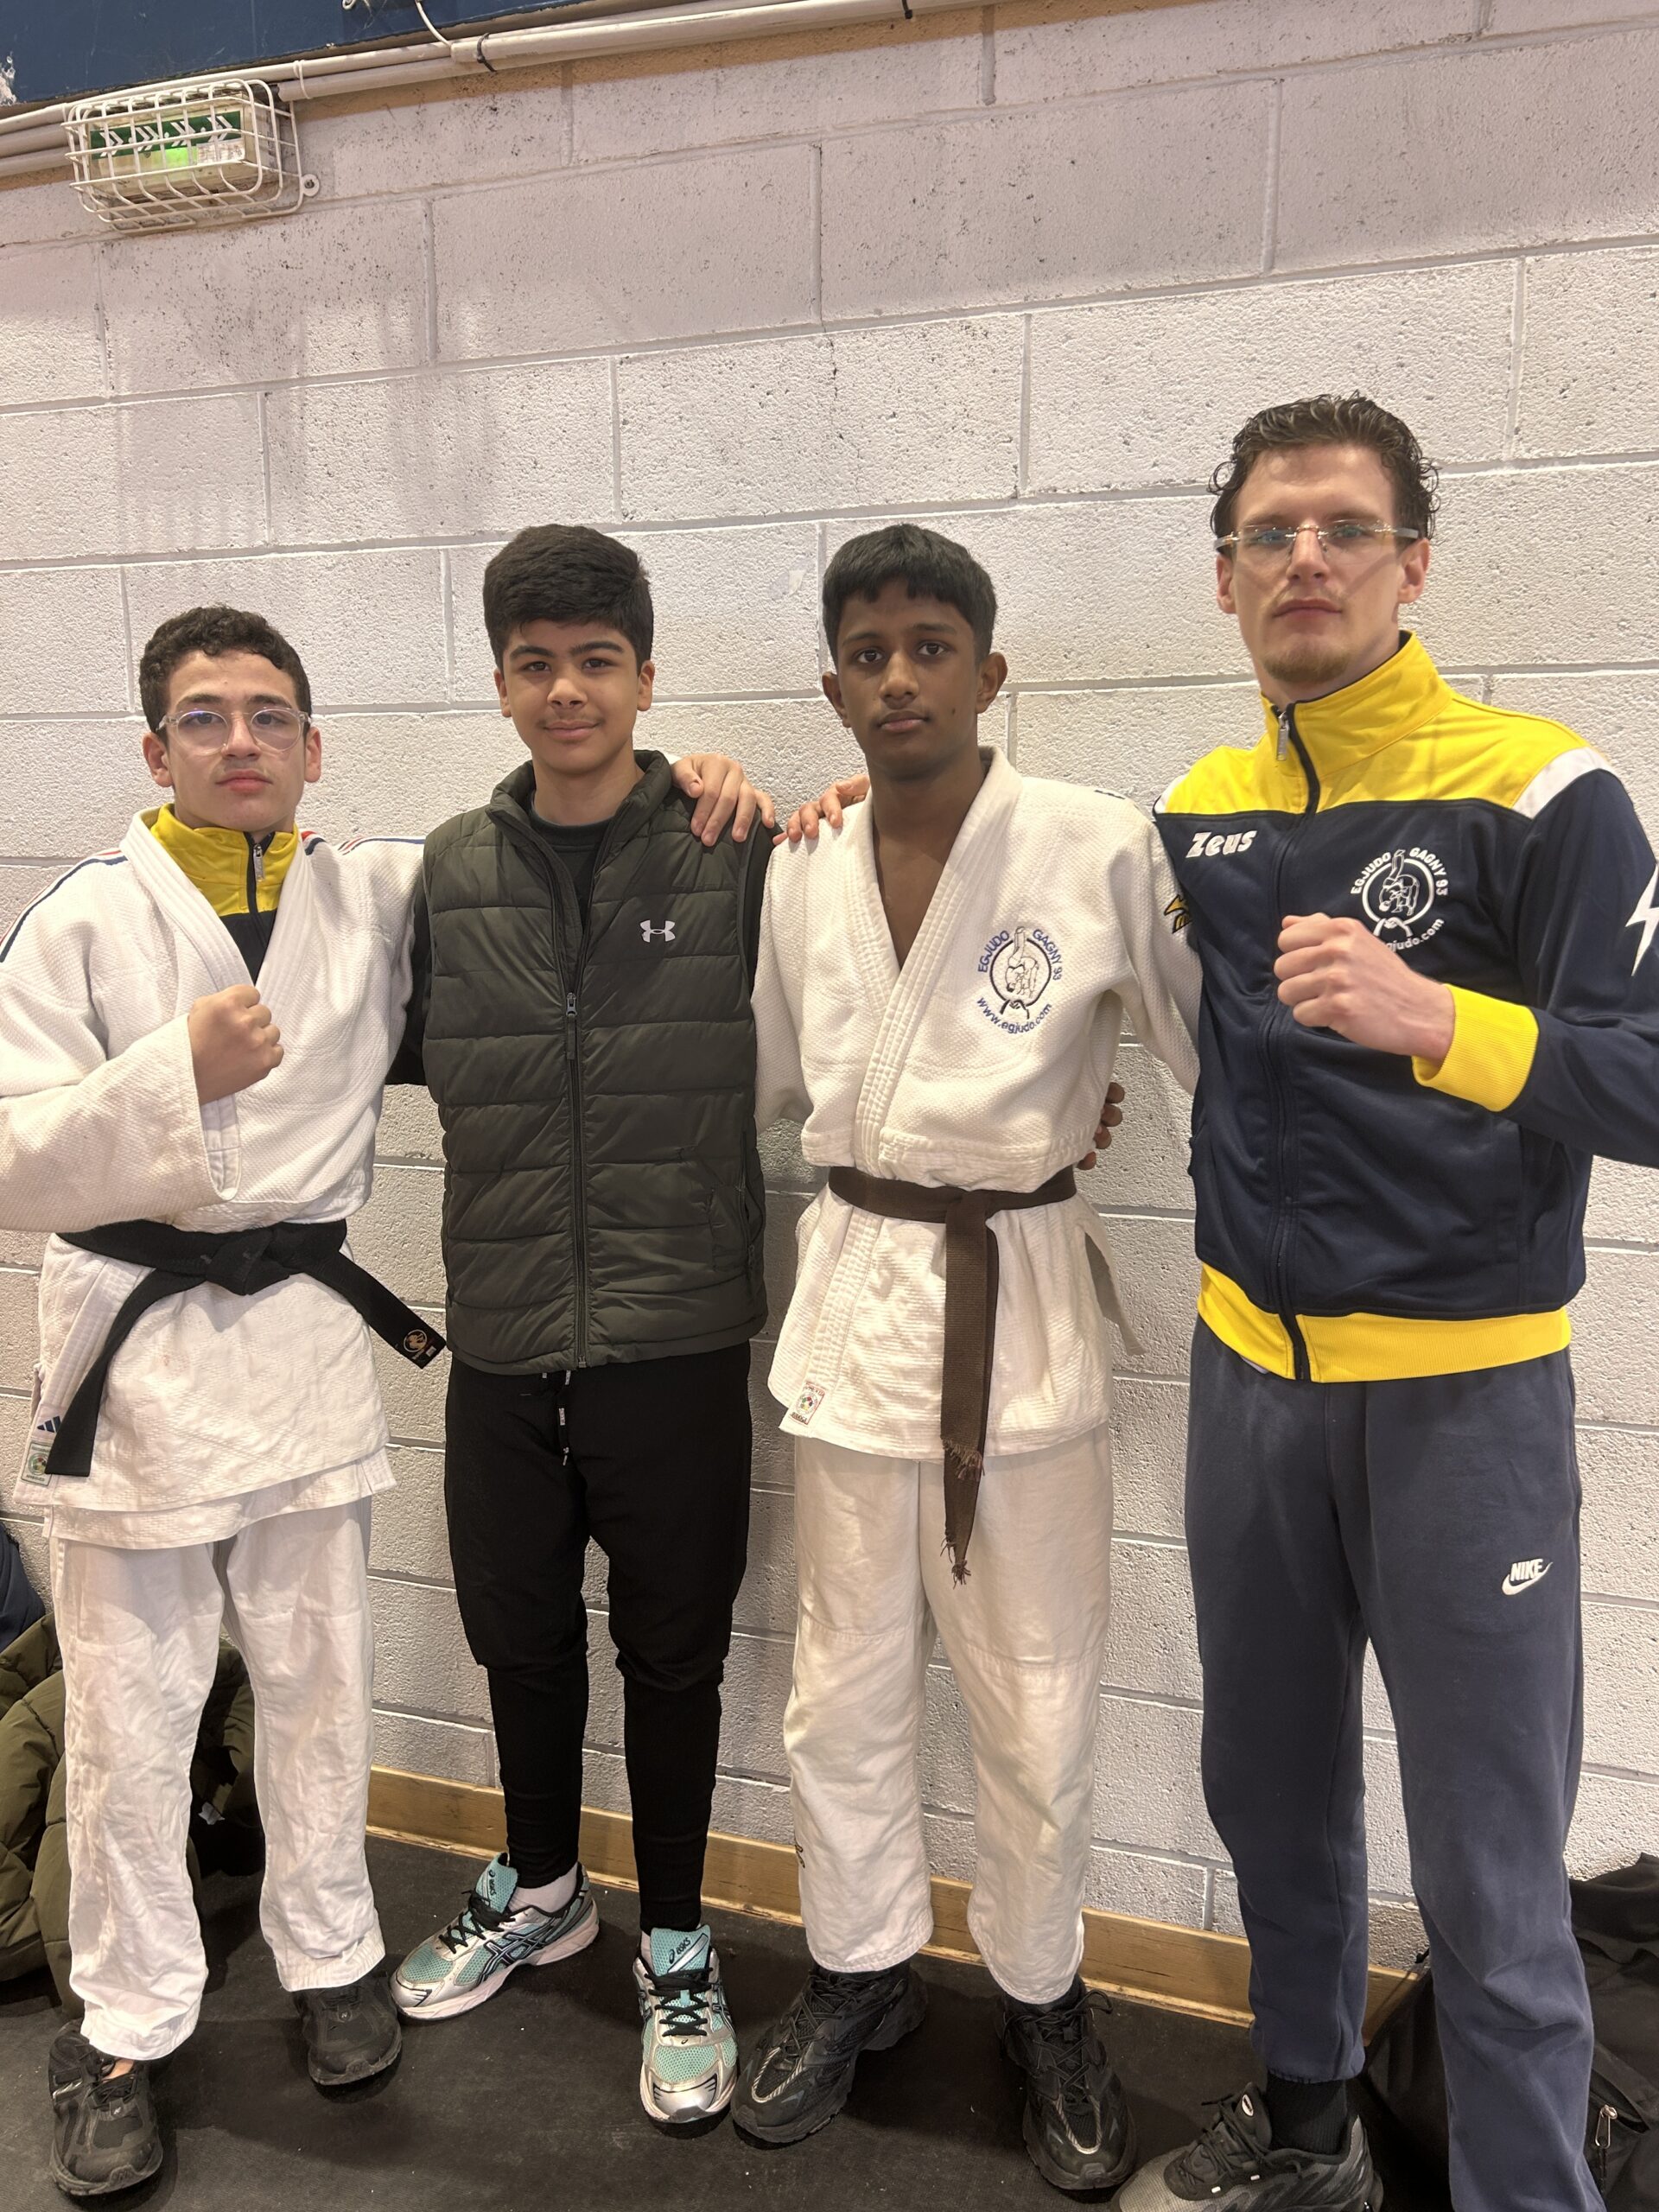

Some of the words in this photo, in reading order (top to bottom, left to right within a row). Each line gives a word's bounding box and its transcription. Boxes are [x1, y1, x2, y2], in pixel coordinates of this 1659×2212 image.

[1185, 830, 1257, 858] Zeus
[1351, 852, 1391, 894] EGJUDO
[1409, 847, 1447, 876] GAGNY
[1435, 879, 1449, 896] 93
[978, 930, 1010, 973] EGJUDO
[1033, 929, 1062, 965] GAGNY
[1052, 966, 1063, 981] 93
[976, 997, 1052, 1034] www.egjudo.com
[1510, 1558, 1544, 1582] NIKE
